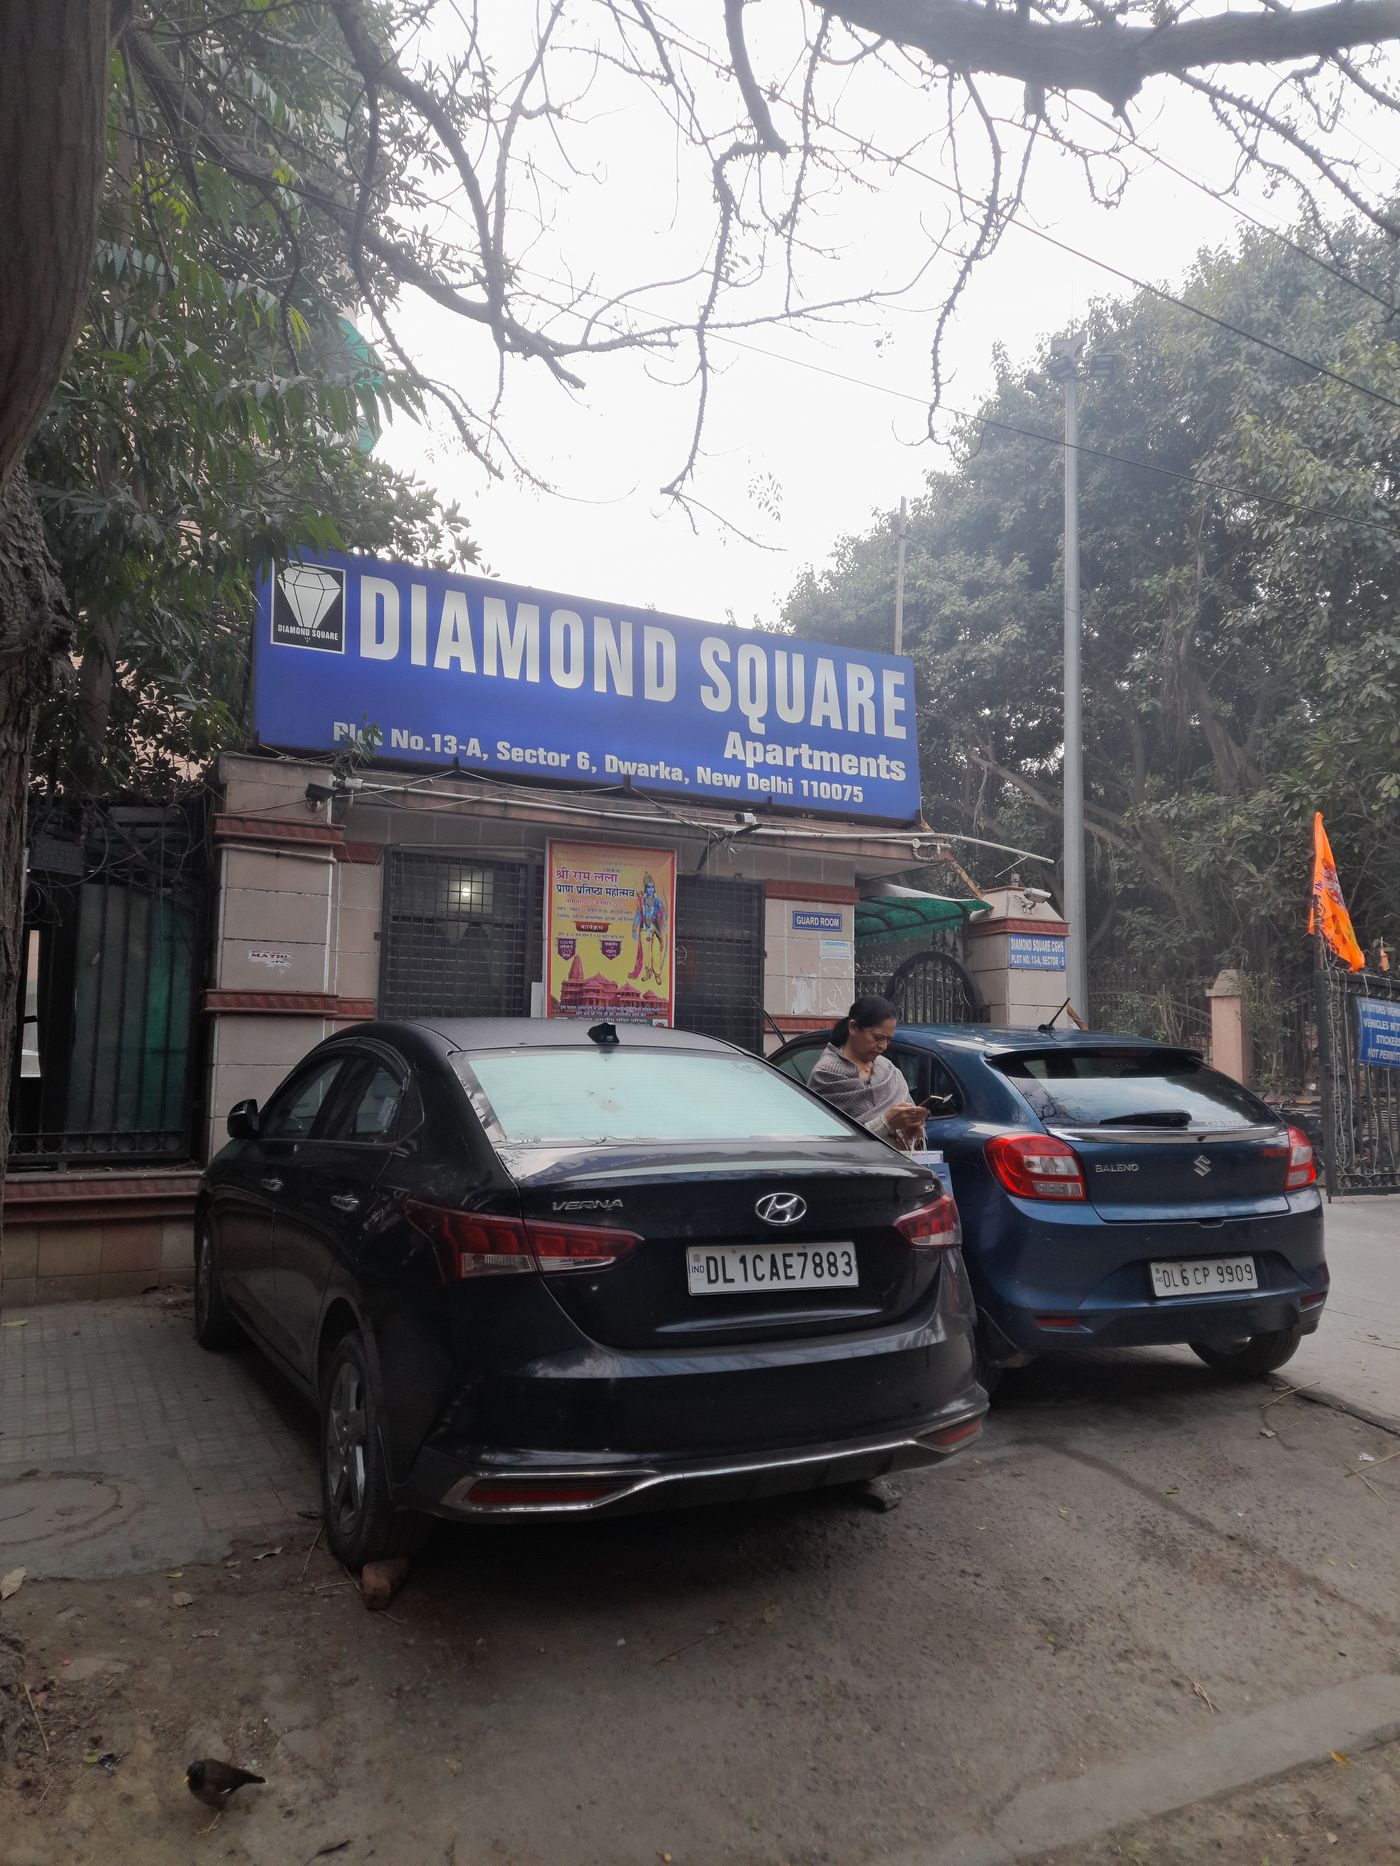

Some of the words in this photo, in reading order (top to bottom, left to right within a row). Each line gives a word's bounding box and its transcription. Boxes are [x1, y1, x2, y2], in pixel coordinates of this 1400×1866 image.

[277, 624, 311, 636] DIAMOND
[311, 629, 339, 641] SQUARE
[360, 575, 676, 702] DIAMOND
[700, 637, 907, 739] SQUARE
[724, 731, 906, 781] Apartments
[497, 741, 570, 769] Sector
[576, 751, 597, 774] 6,
[605, 754, 689, 784] Dwarka,
[697, 766, 741, 788] New
[747, 772, 793, 795] Delhi
[800, 779, 863, 803] 110075
[556, 866, 569, 880] श्री
[572, 871, 591, 881] राम
[594, 873, 618, 884] लला
[556, 884, 574, 894] प्राण
[576, 883, 602, 896] प्रतिष्ठा
[605, 885, 635, 898] महोत्सव
[796, 916, 819, 926] GUARD
[820, 917, 840, 927] ROOM
[1011, 938, 1032, 951] DIAMOND
[1032, 939, 1051, 952] SQUARE
[1011, 954, 1022, 964] PLOT
[1042, 956, 1059, 966] SECTOR
[1363, 1018, 1389, 1030] VEHICLES
[1095, 1163, 1140, 1173] BALENO
[552, 1199, 624, 1211] VERNA
[706, 1250, 854, 1285] DL1CAE7883
[1216, 1263, 1253, 1284] 9909
